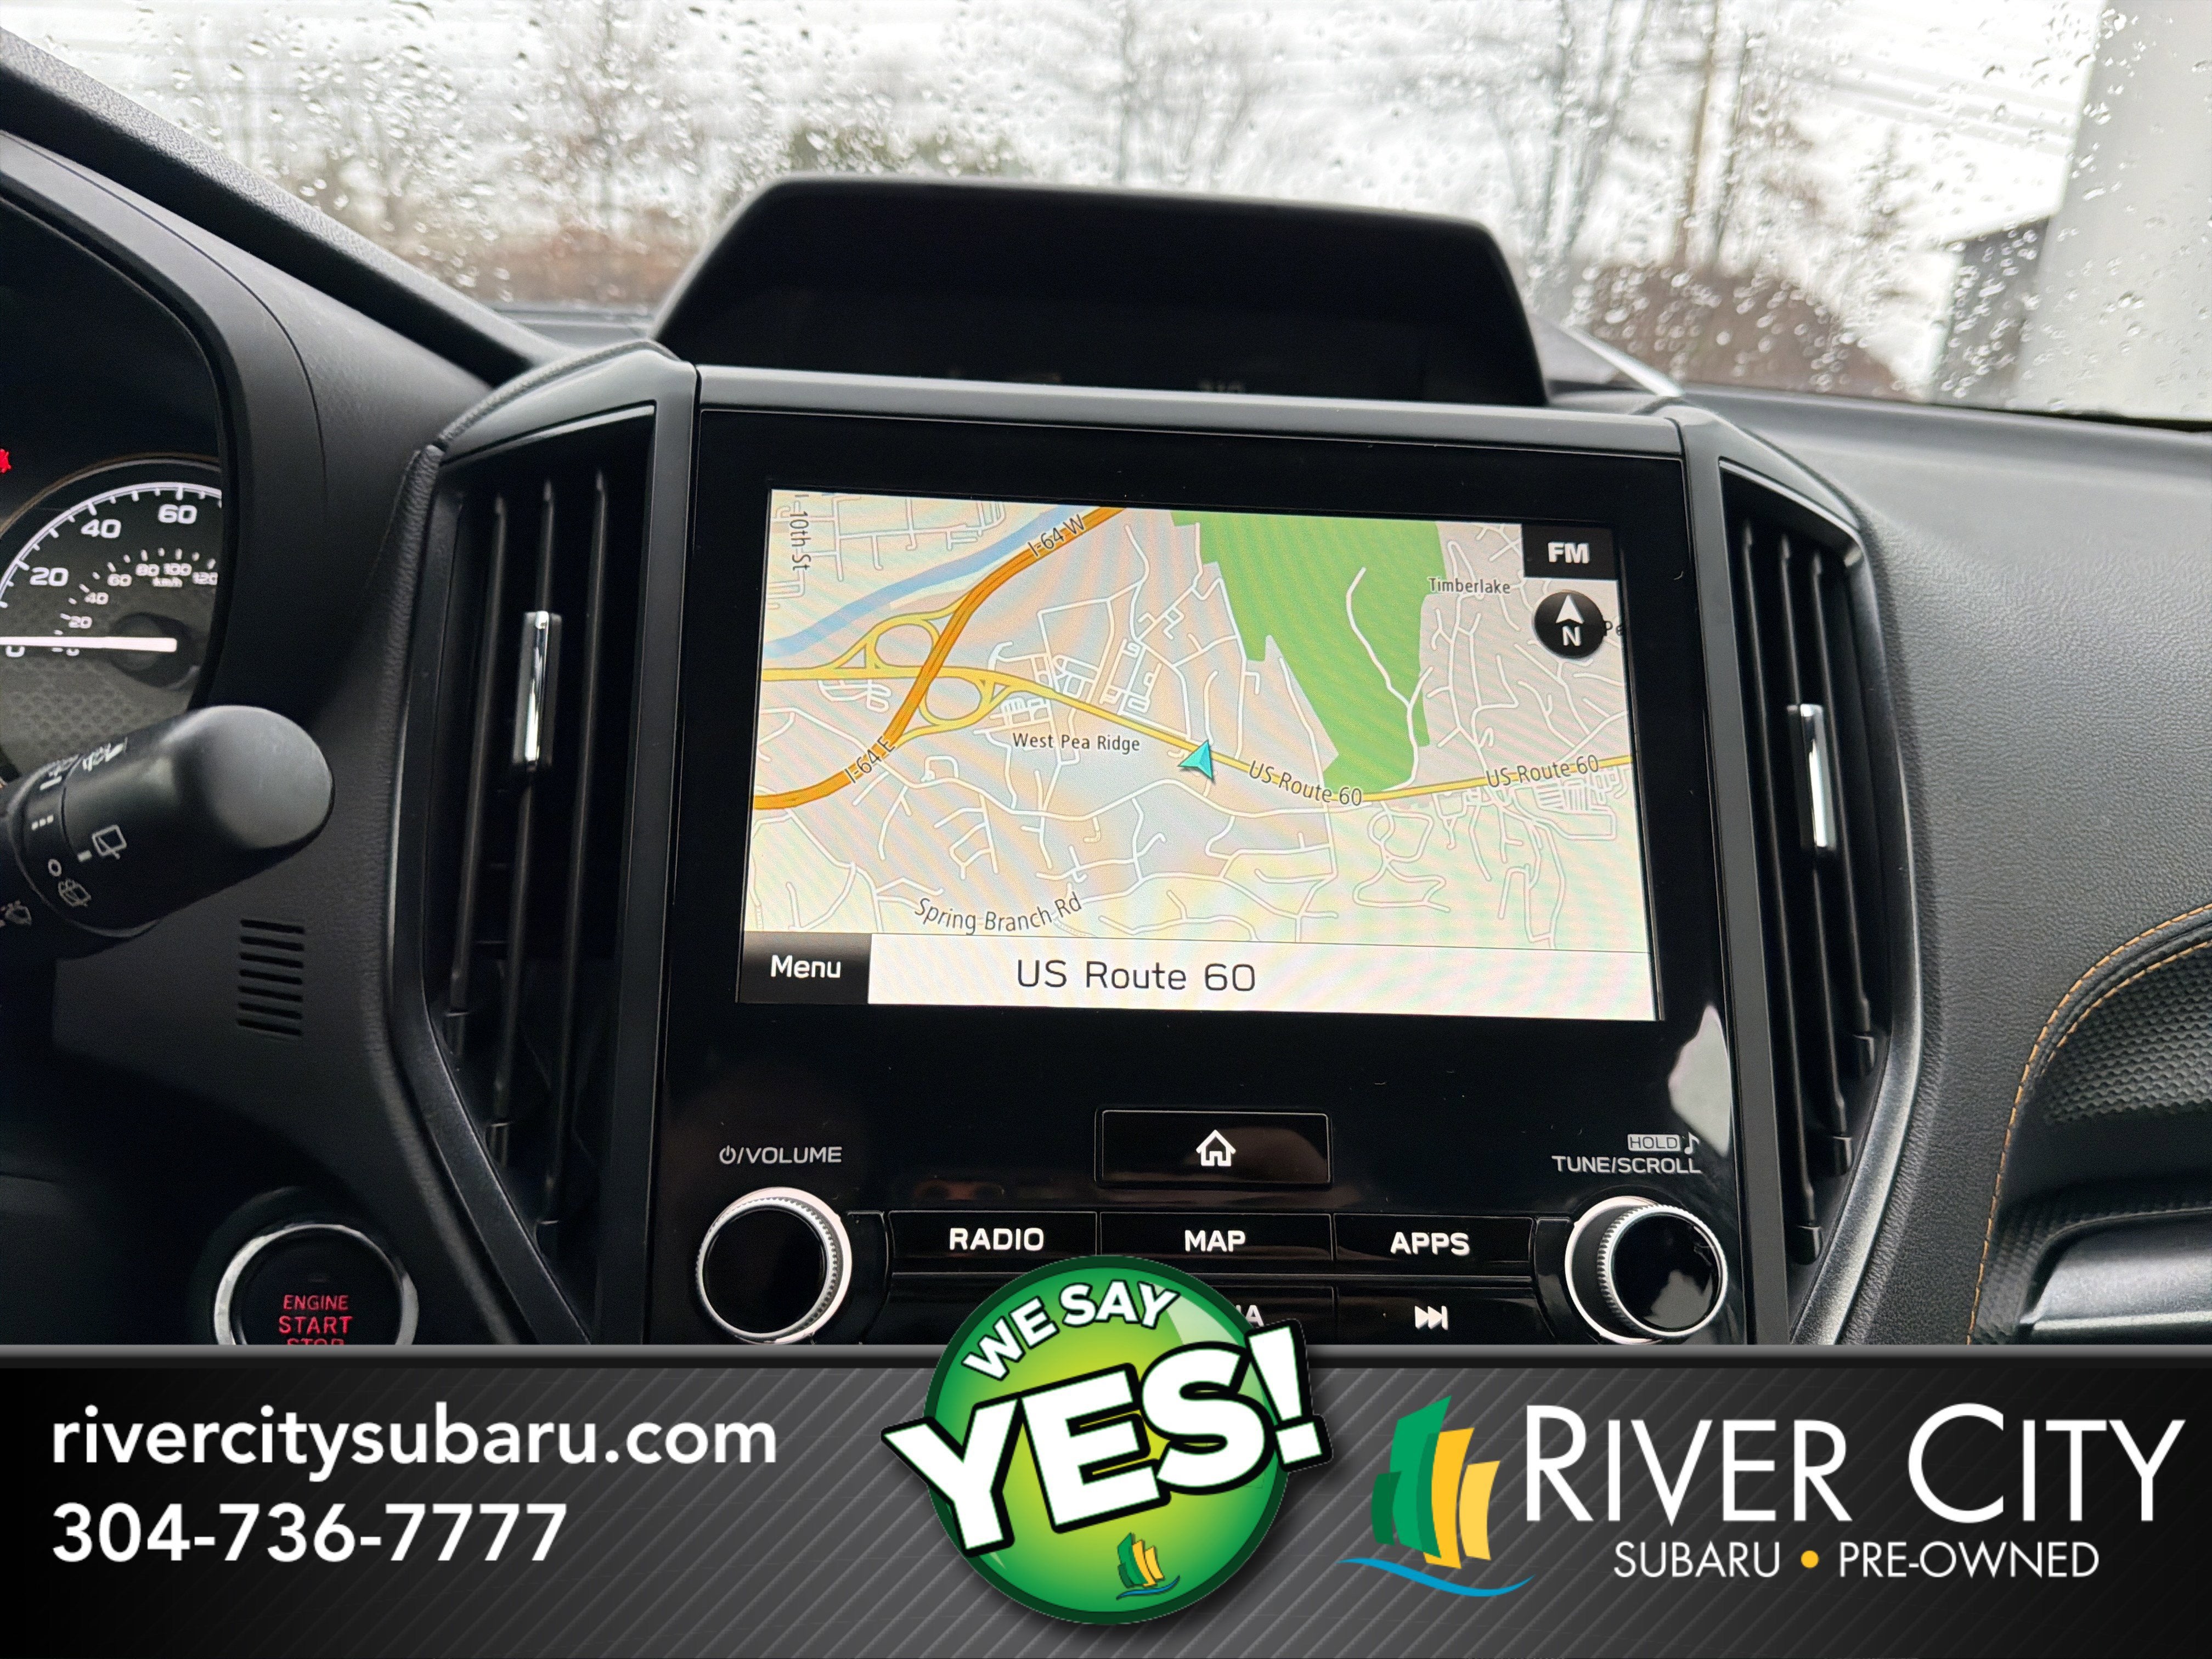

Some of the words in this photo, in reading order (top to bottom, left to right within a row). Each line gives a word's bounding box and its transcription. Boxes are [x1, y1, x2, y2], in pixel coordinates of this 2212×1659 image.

[157, 504, 198, 524] 60
[81, 519, 121, 539] 40
[789, 511, 811, 547] 10th
[1061, 515, 1086, 538] W
[792, 554, 811, 571] St
[1548, 542, 1589, 564] FM
[29, 567, 69, 586] 20
[135, 563, 160, 577] 80
[163, 563, 192, 576] 100
[107, 573, 132, 587] 60
[1428, 577, 1511, 595] Timberlake
[84, 592, 109, 605] 40
[69, 616, 92, 629] 20
[1562, 625, 1581, 646] N
[878, 735, 896, 753] E
[1012, 732, 1054, 750] West
[1060, 735, 1091, 751] Pea
[1097, 735, 1141, 755] Ridge
[1486, 768, 1512, 788] US
[1516, 761, 1570, 783] Route
[1576, 754, 1600, 774] 60
[1249, 760, 1274, 782] US
[1278, 772, 1333, 803] Route
[1339, 787, 1363, 806] 60
[915, 898, 977, 936] Spring
[984, 907, 1053, 933] Branch
[1053, 891, 1083, 917] Rd
[770, 955, 842, 979] Menu
[1017, 959, 1068, 989] US
[1086, 961, 1187, 990] Route
[1204, 963, 1256, 992] 60
[1628, 1135, 1680, 1150] HOLD
[1551, 1155, 1701, 1175] TUNE/SCROLL
[949, 1227, 1045, 1251] RADIO
[1184, 1229, 1246, 1252] MAP
[1390, 1231, 1471, 1256] APPS
[283, 1294, 350, 1311] ENGINE
[278, 1315, 353, 1335] START
